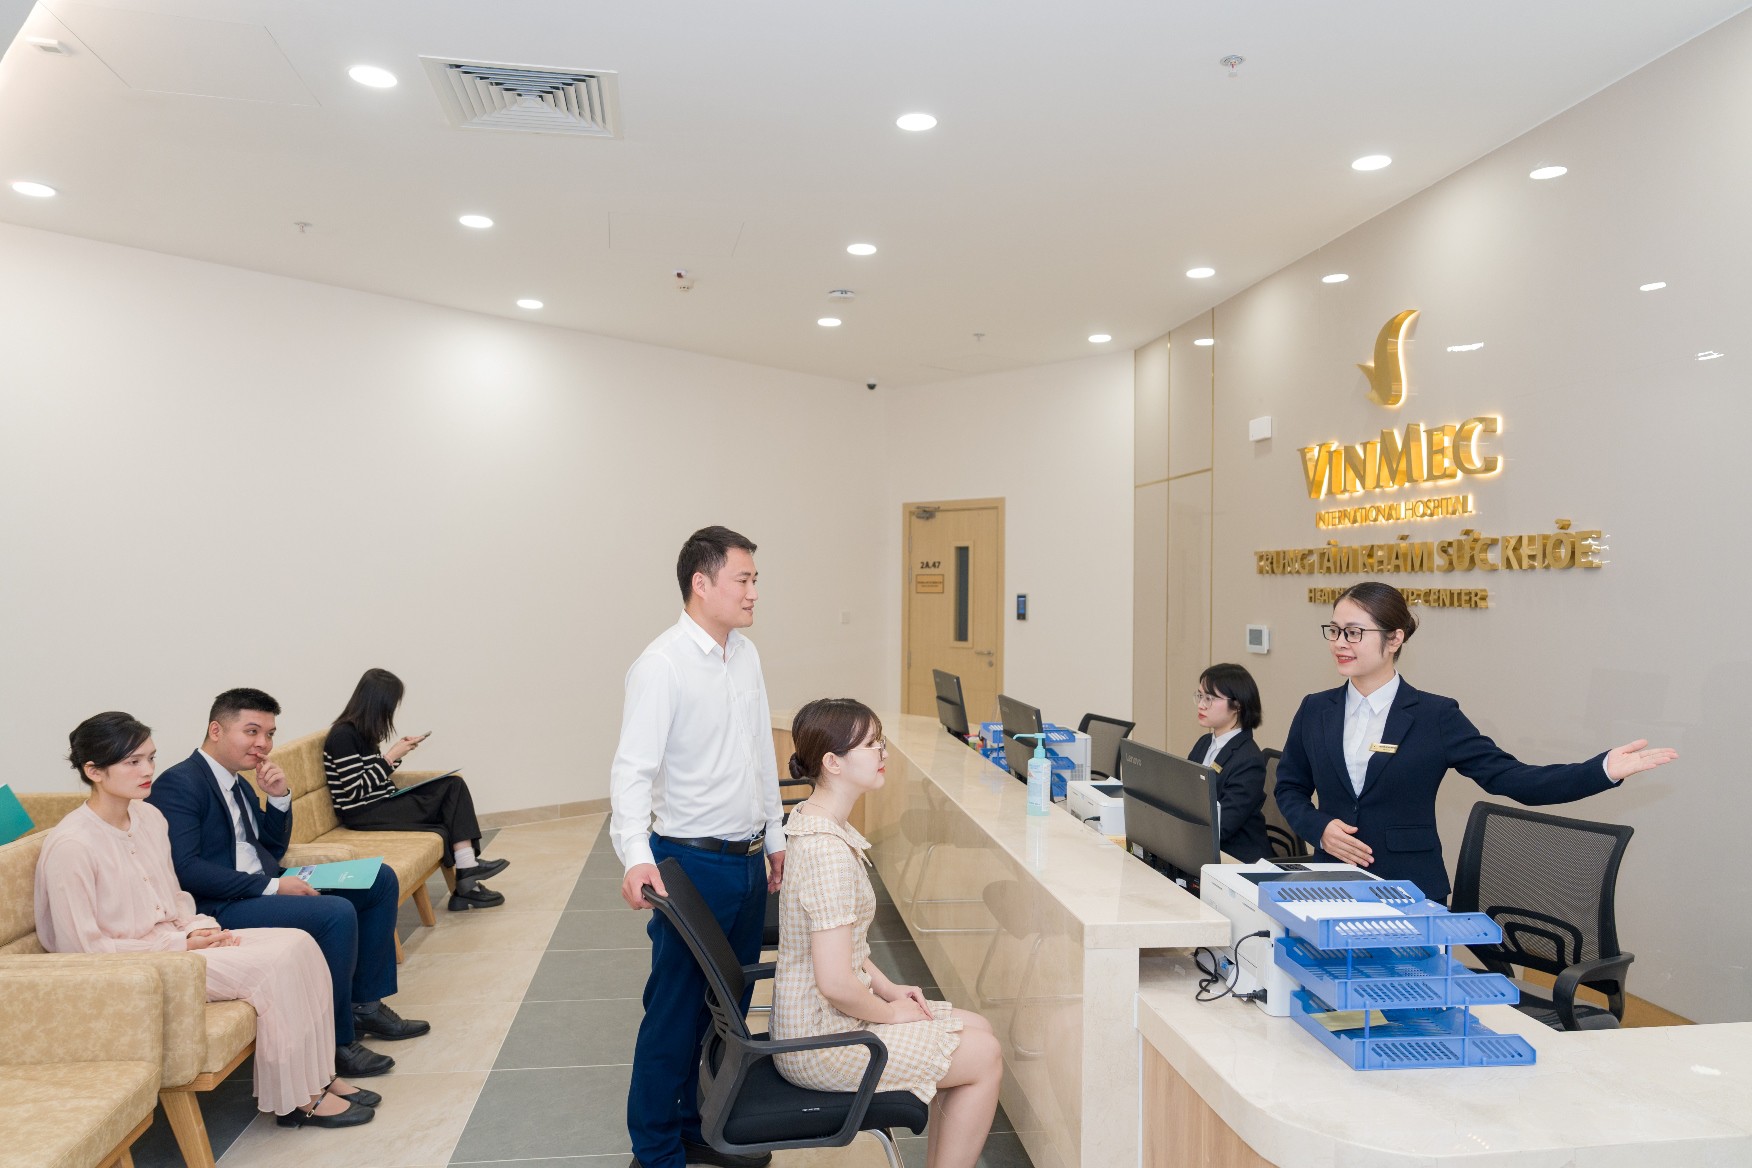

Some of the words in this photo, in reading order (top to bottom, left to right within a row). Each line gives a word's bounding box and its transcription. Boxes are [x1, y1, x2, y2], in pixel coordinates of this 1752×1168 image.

[1315, 502, 1404, 528] INTERNATIONAL
[1405, 495, 1473, 519] HOSPITAL
[1254, 549, 1312, 574] TRUNG
[1313, 539, 1358, 573] TÂM
[1359, 534, 1434, 572] KHÁM
[1436, 528, 1499, 572] SỨC
[1501, 518, 1602, 570] KHỎE
[920, 560, 941, 569] 2A.47
[1421, 588, 1487, 608] CENTER
